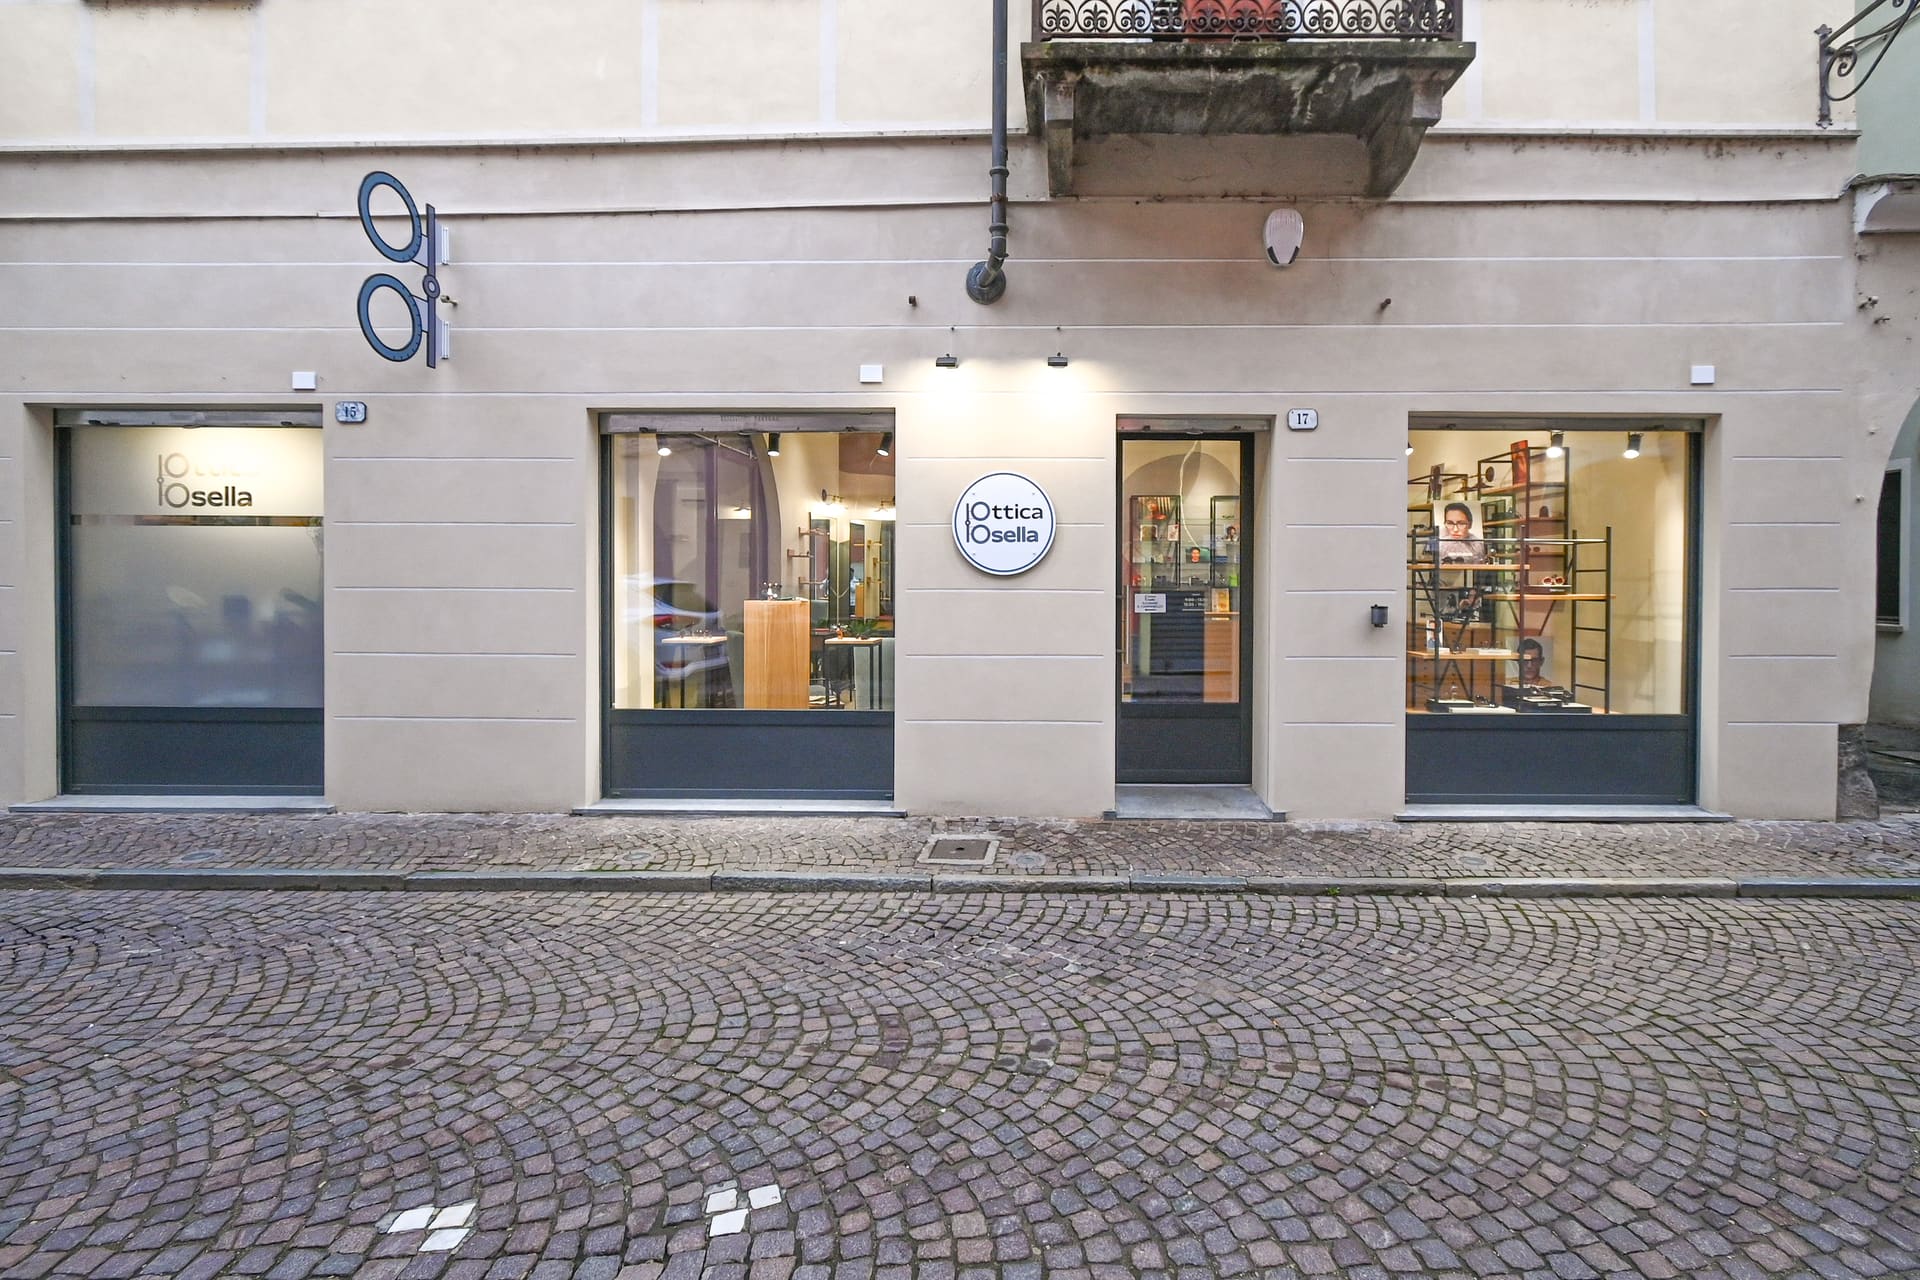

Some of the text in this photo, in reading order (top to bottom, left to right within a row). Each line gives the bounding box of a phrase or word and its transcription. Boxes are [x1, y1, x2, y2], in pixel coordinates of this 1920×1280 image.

[345, 406, 356, 418] 15
[1297, 413, 1309, 425] 17
[165, 482, 252, 508] Osella
[970, 501, 1043, 522] Ottica
[970, 524, 1039, 544] Osella
